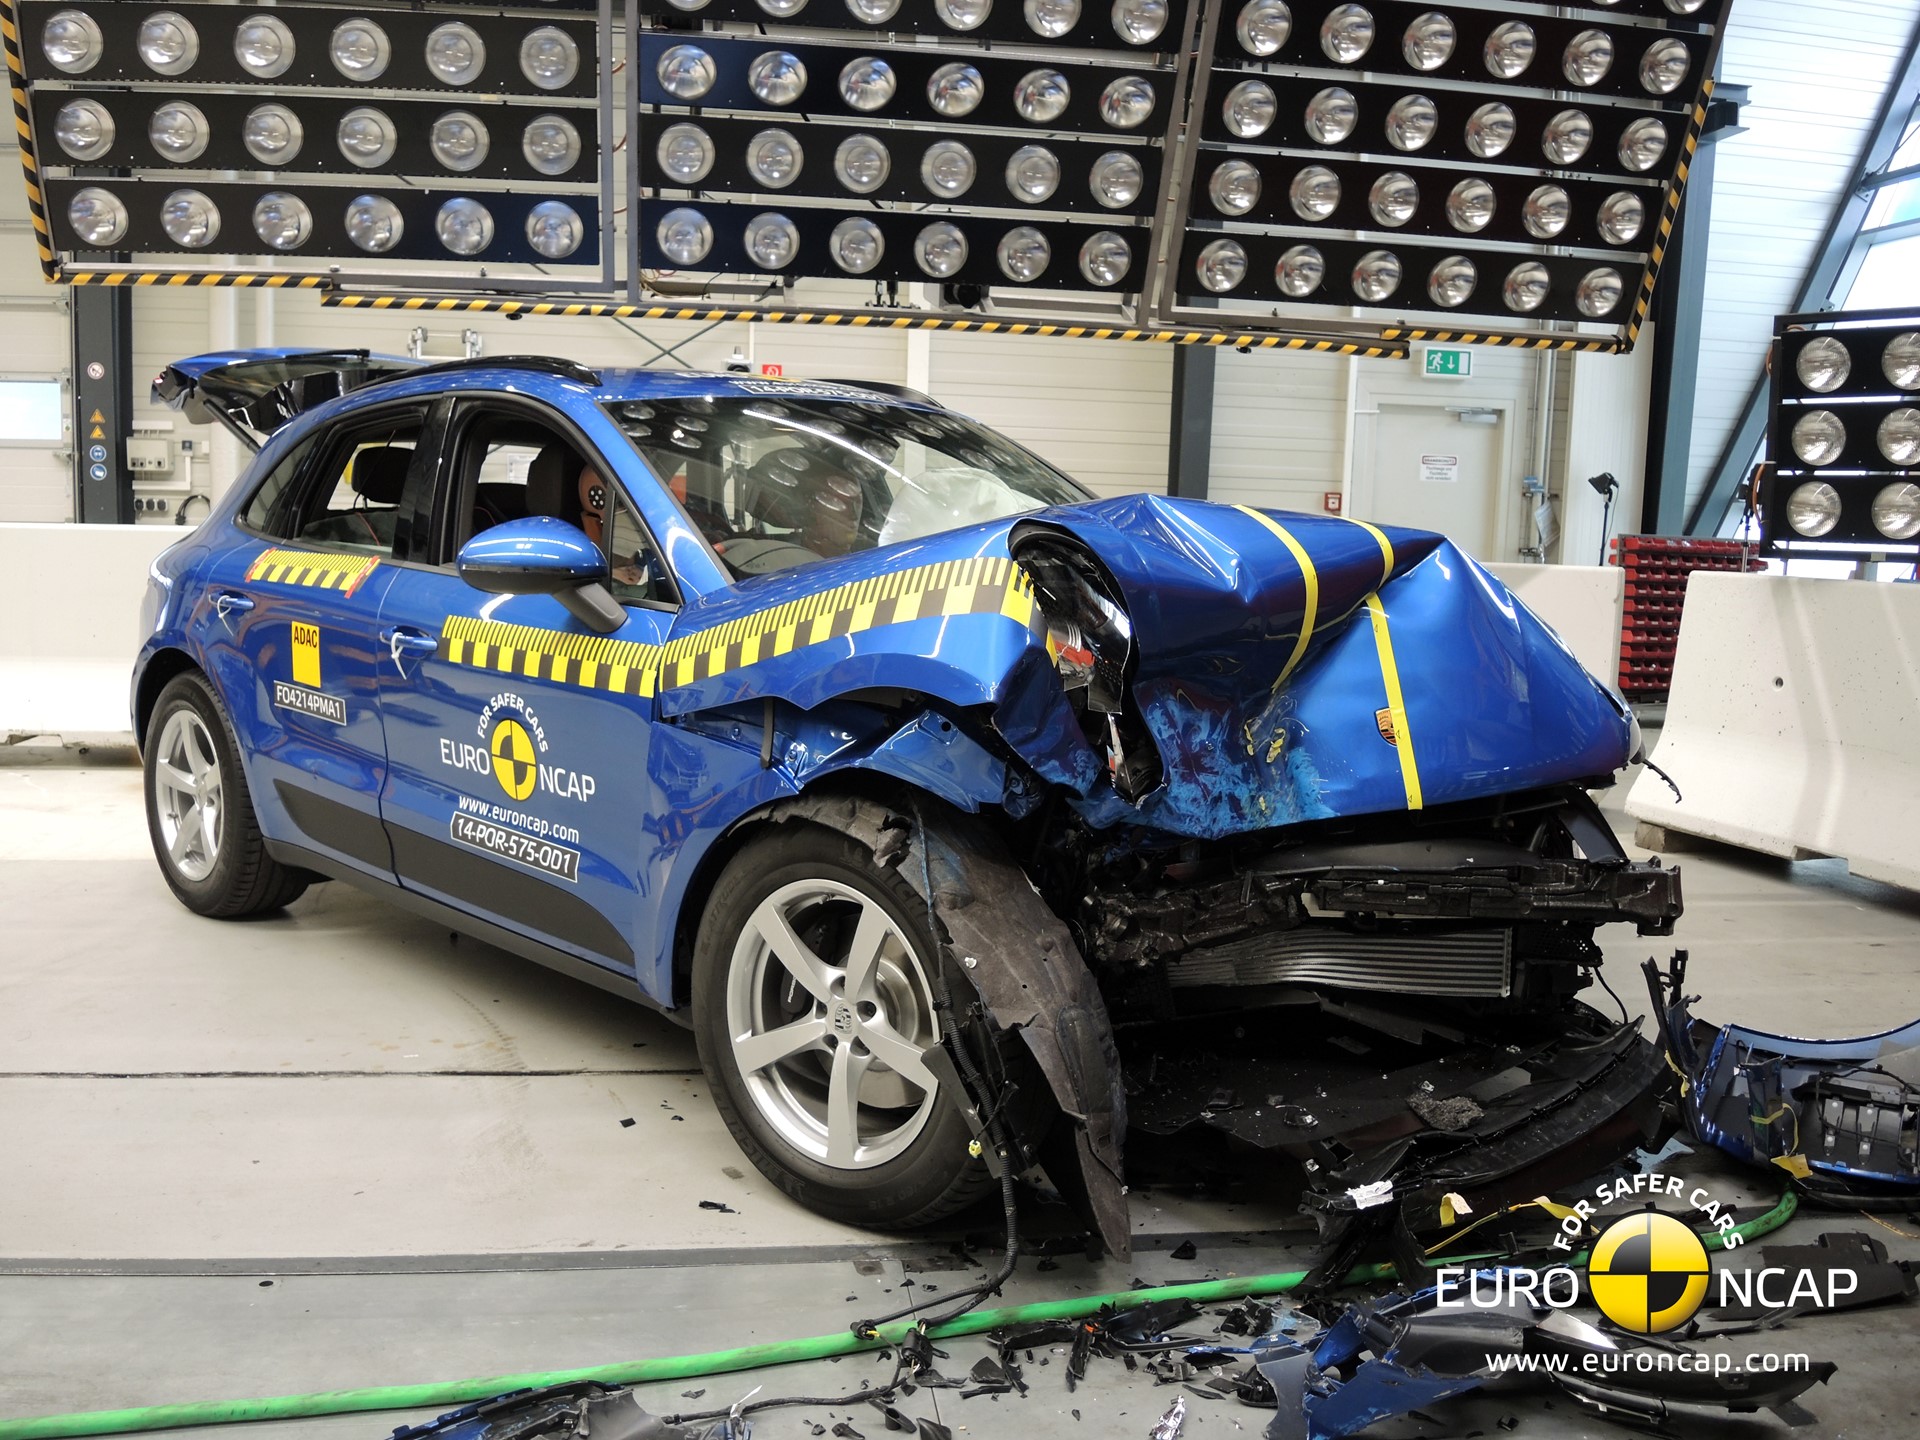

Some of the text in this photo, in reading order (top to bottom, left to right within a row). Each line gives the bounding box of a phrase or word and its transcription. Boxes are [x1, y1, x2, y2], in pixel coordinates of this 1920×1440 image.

[294, 626, 317, 648] ADAC
[477, 693, 548, 752] FOR SAFER CARS
[440, 738, 595, 802] EURO NCAP
[459, 795, 579, 844] www.euroncap.com
